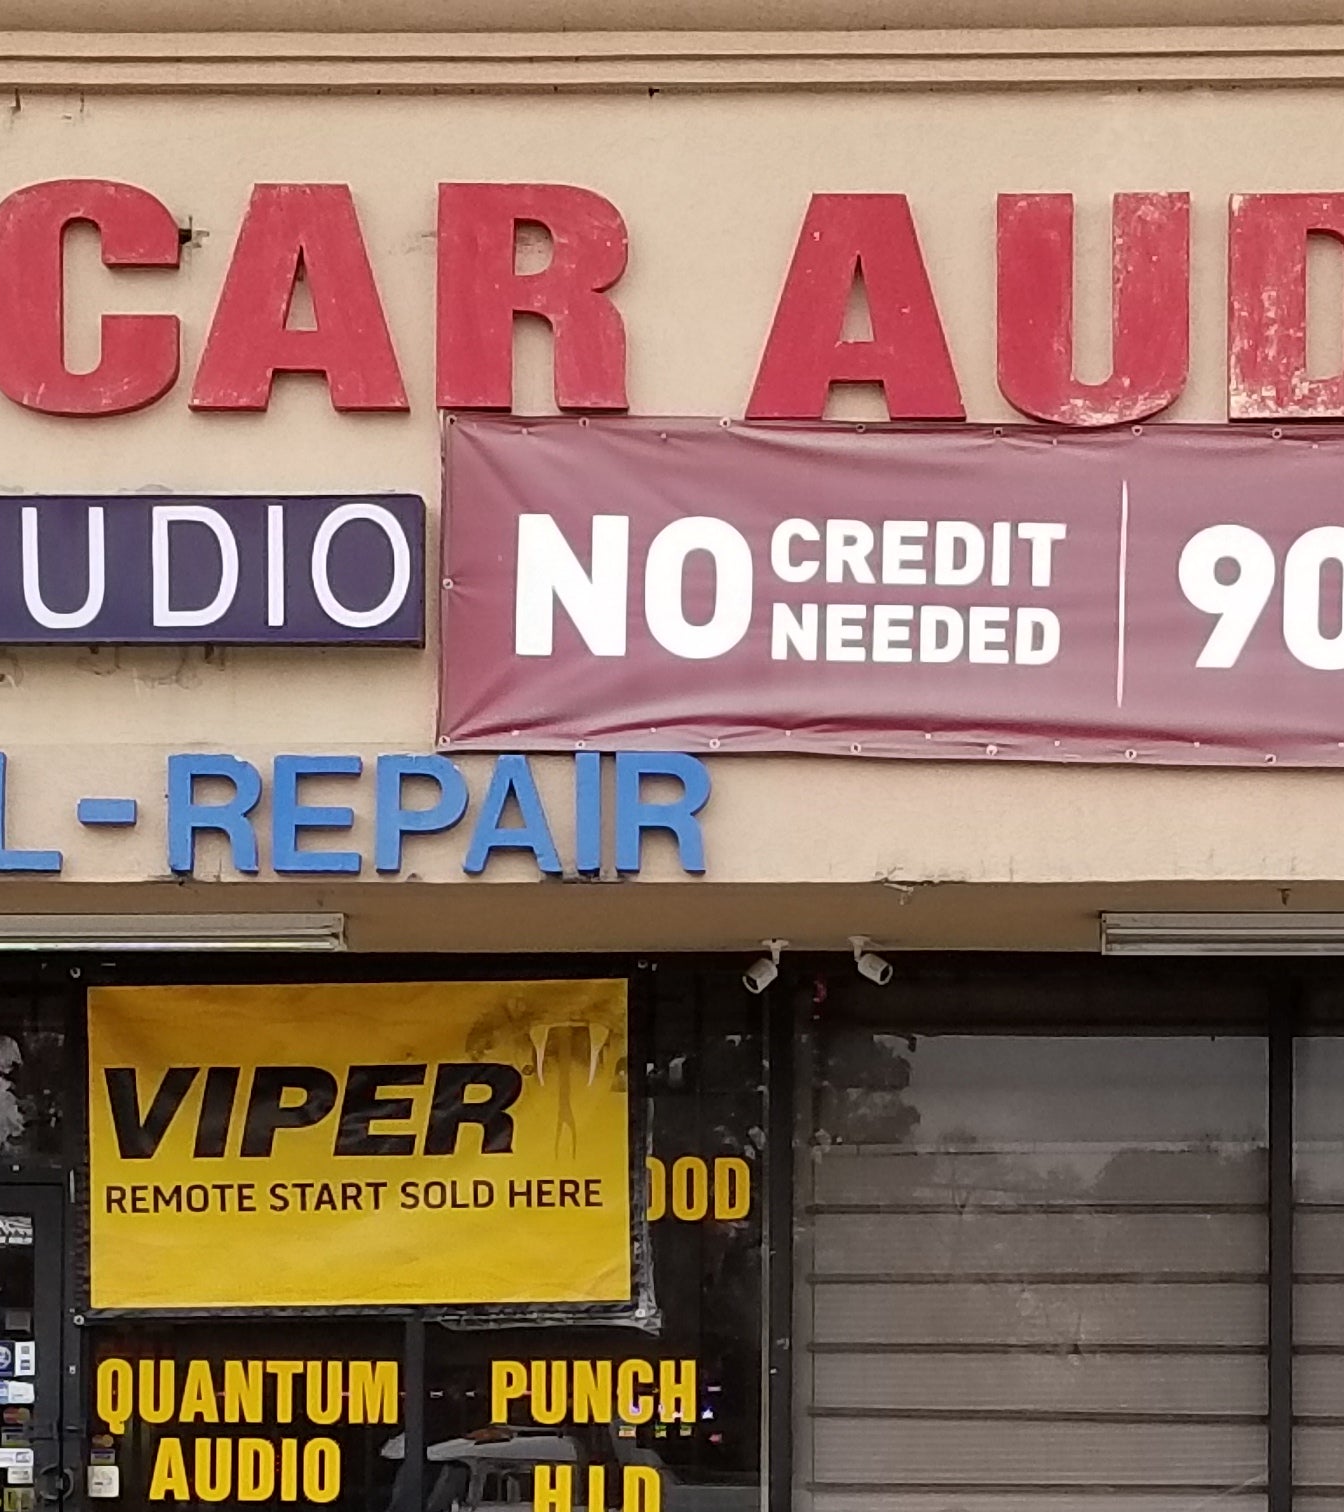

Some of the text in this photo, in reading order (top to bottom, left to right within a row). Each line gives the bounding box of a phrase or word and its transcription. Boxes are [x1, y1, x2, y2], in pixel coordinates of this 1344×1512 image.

[771, 519, 1066, 586] CREDIT
[515, 514, 753, 659] NO
[770, 602, 1062, 665] NEEDED
[103, 1064, 523, 1159] VIPER
[105, 1179, 603, 1213] REMOTE START SOLD HERE
[96, 1358, 398, 1434] QUANTUM
[491, 1359, 697, 1423] PUNCH
[150, 1438, 341, 1502] AUDIO
